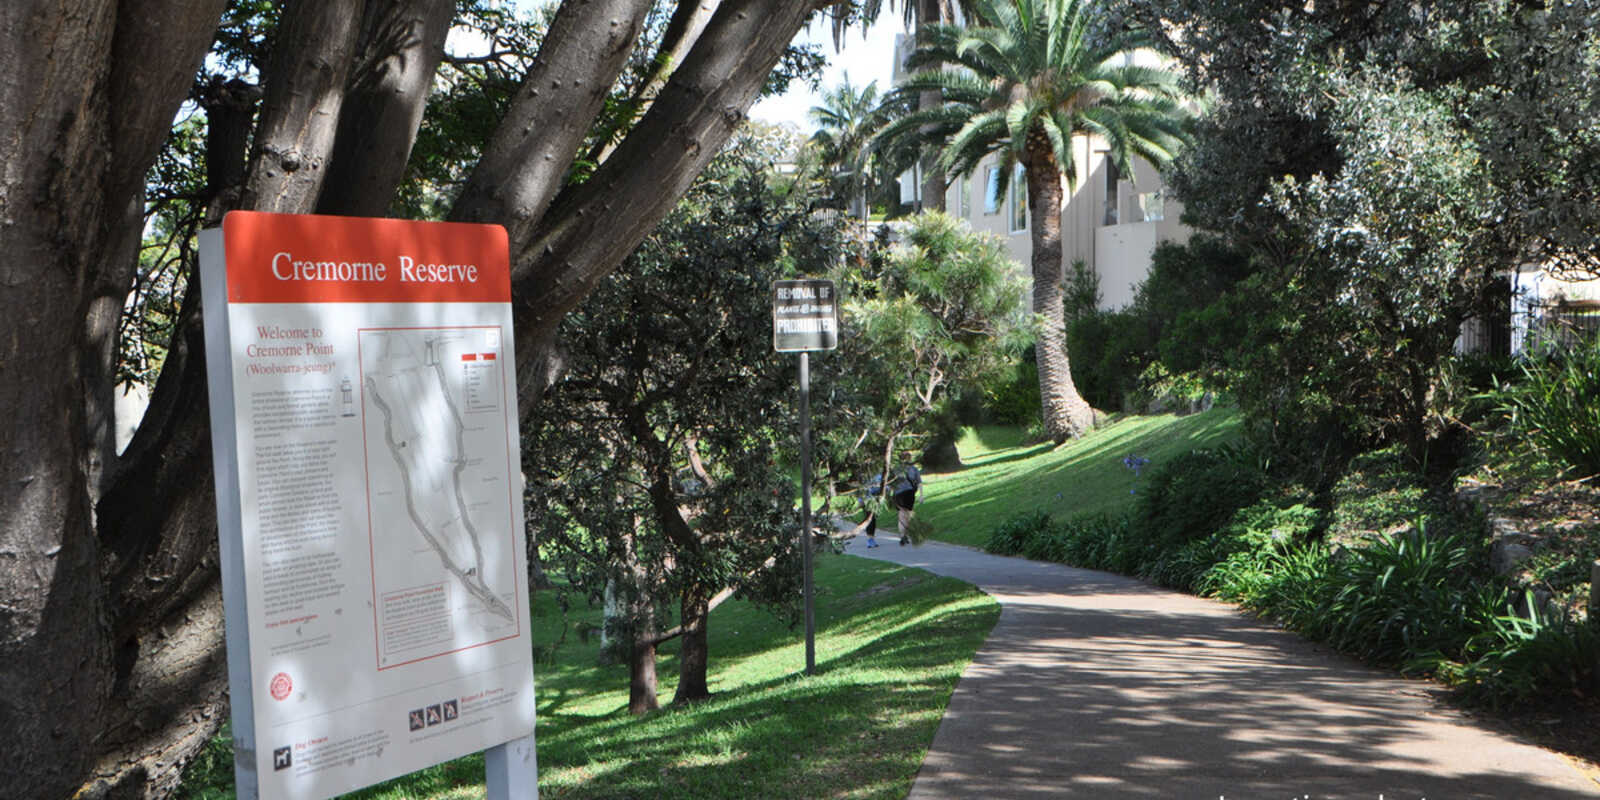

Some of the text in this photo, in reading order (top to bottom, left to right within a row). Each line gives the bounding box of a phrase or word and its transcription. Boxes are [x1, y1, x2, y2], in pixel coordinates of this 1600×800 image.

[271, 251, 478, 284] Cremorne Reserve
[777, 287, 832, 300] REMOVAL OF
[256, 326, 324, 340] Welcome to
[777, 318, 836, 334] PROHIBITED
[246, 342, 335, 358] Cremorne Point
